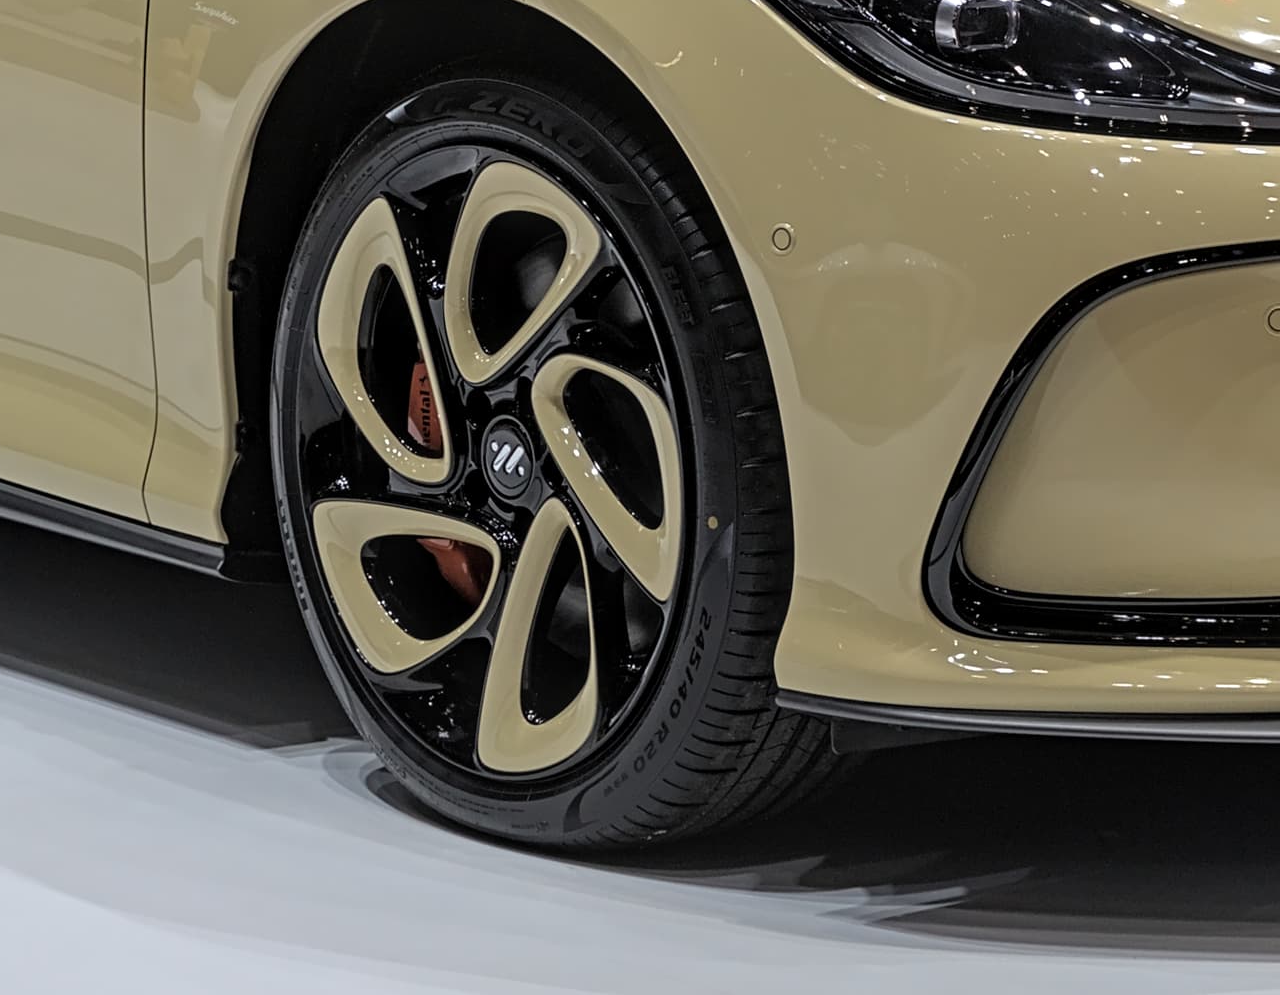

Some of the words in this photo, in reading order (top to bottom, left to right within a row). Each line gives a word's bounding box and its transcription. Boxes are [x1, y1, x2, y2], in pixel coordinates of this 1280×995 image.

[468, 90, 598, 160] ZERO
[669, 606, 713, 719] 245/40
[632, 721, 671, 774] R20
